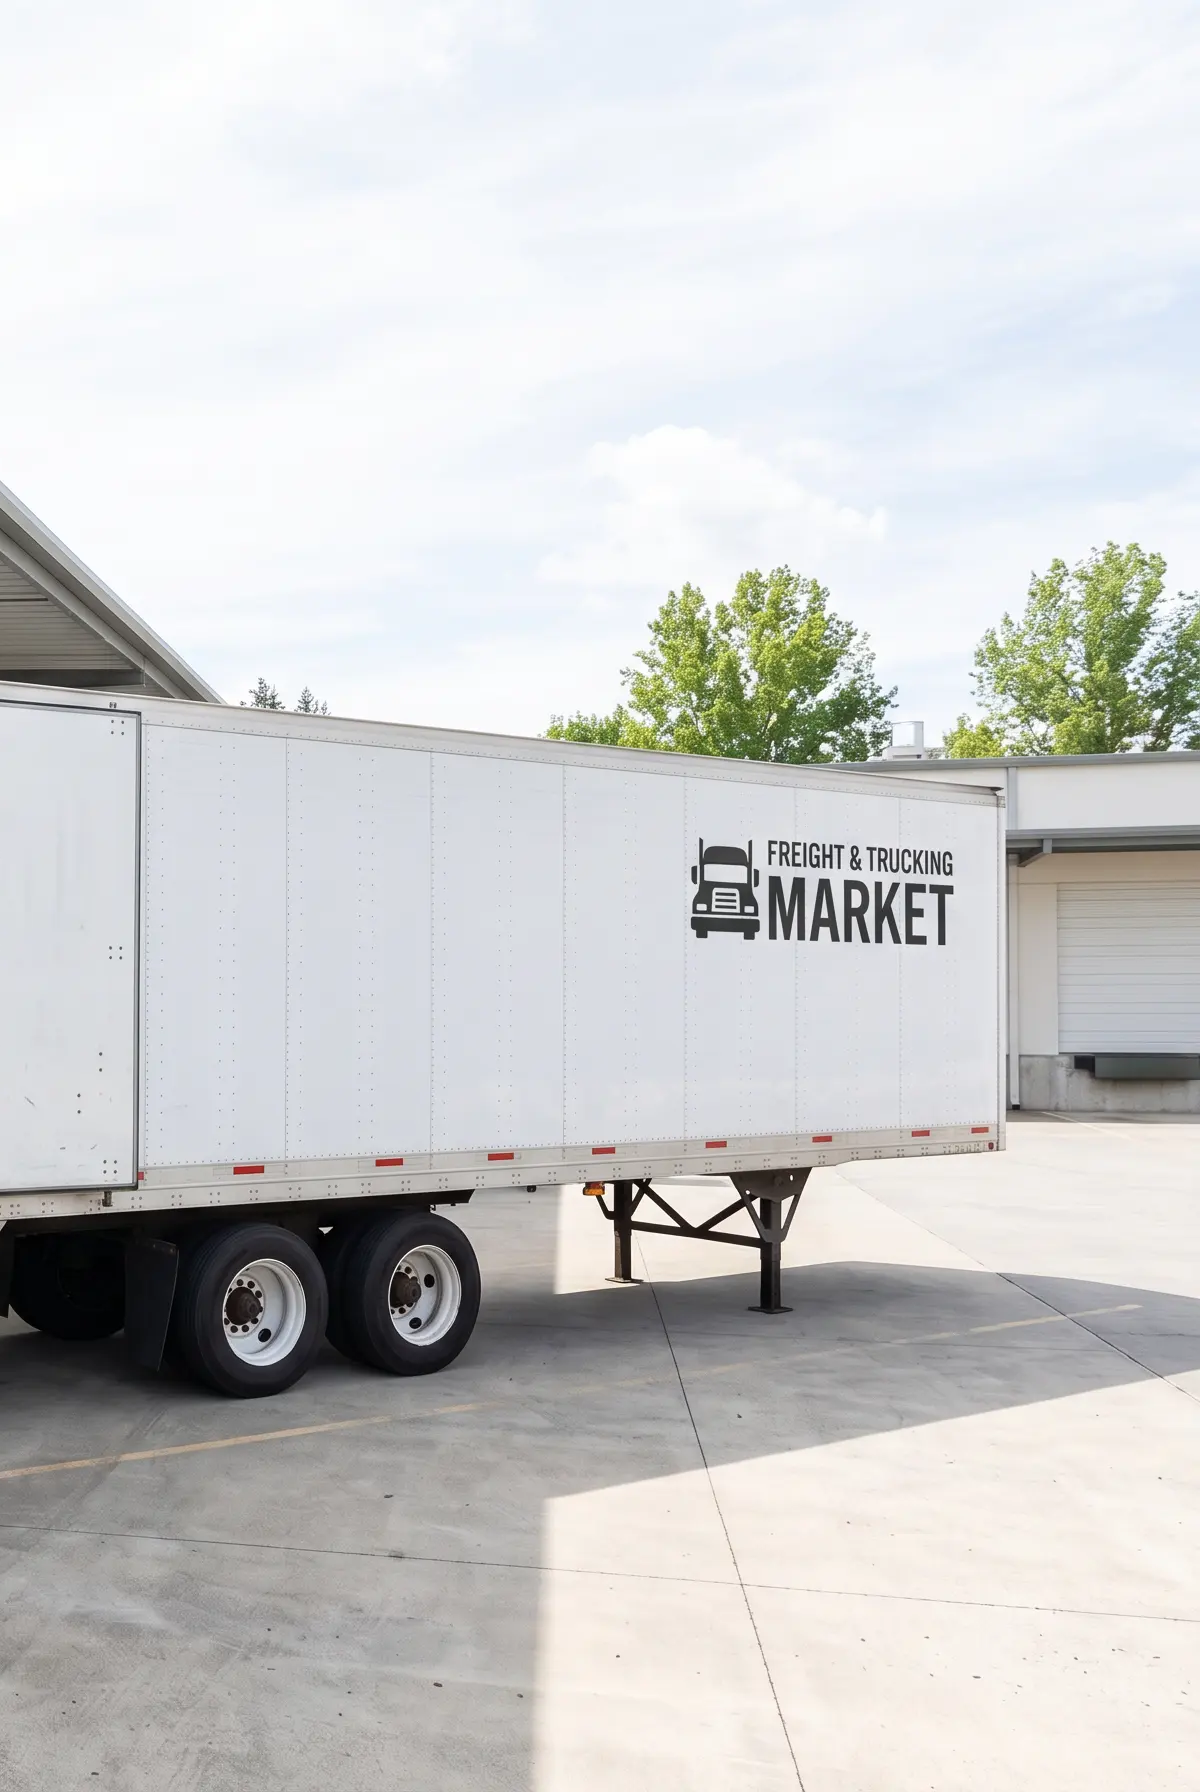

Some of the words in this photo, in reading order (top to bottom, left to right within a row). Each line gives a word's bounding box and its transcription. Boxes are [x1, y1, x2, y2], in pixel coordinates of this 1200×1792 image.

[767, 840, 845, 870] FREIGHT
[849, 845, 863, 871] &
[866, 846, 953, 876] TRUCKING
[767, 875, 954, 946] MARKET
